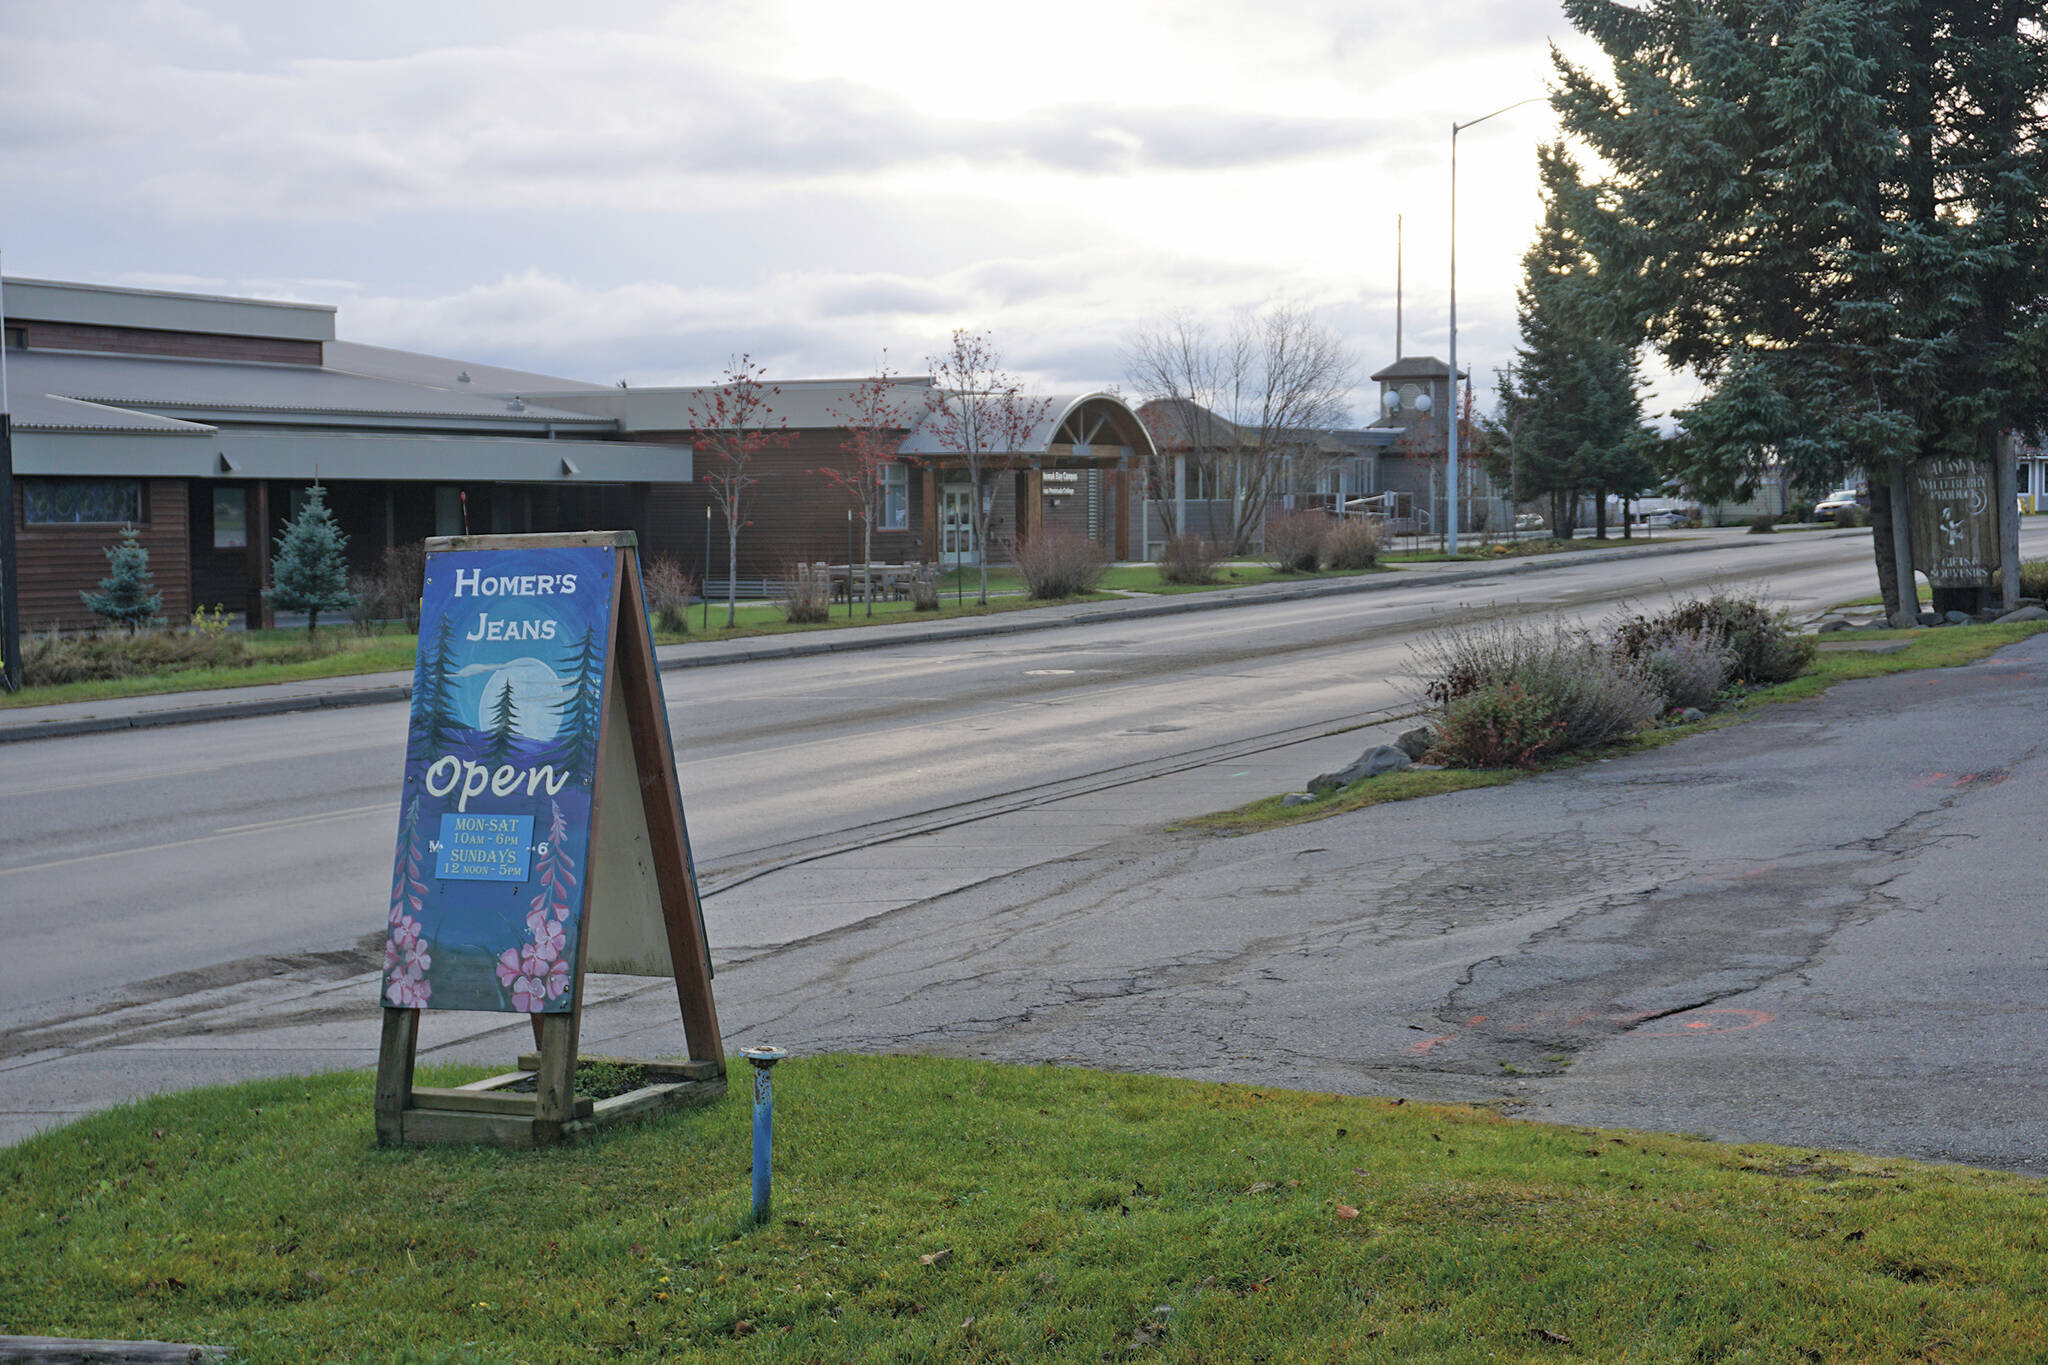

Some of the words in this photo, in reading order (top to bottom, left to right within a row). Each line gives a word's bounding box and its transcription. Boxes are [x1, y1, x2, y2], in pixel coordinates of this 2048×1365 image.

[454, 568, 577, 598] HOMER'S
[466, 612, 557, 642] JEANS
[425, 755, 570, 813] Open
[455, 818, 519, 832] MON-SAT
[454, 832, 484, 844] 10AM
[496, 832, 518, 846] 6PM
[445, 863, 459, 873] 12
[462, 865, 488, 875] NOON
[498, 864, 521, 876] 5PM
